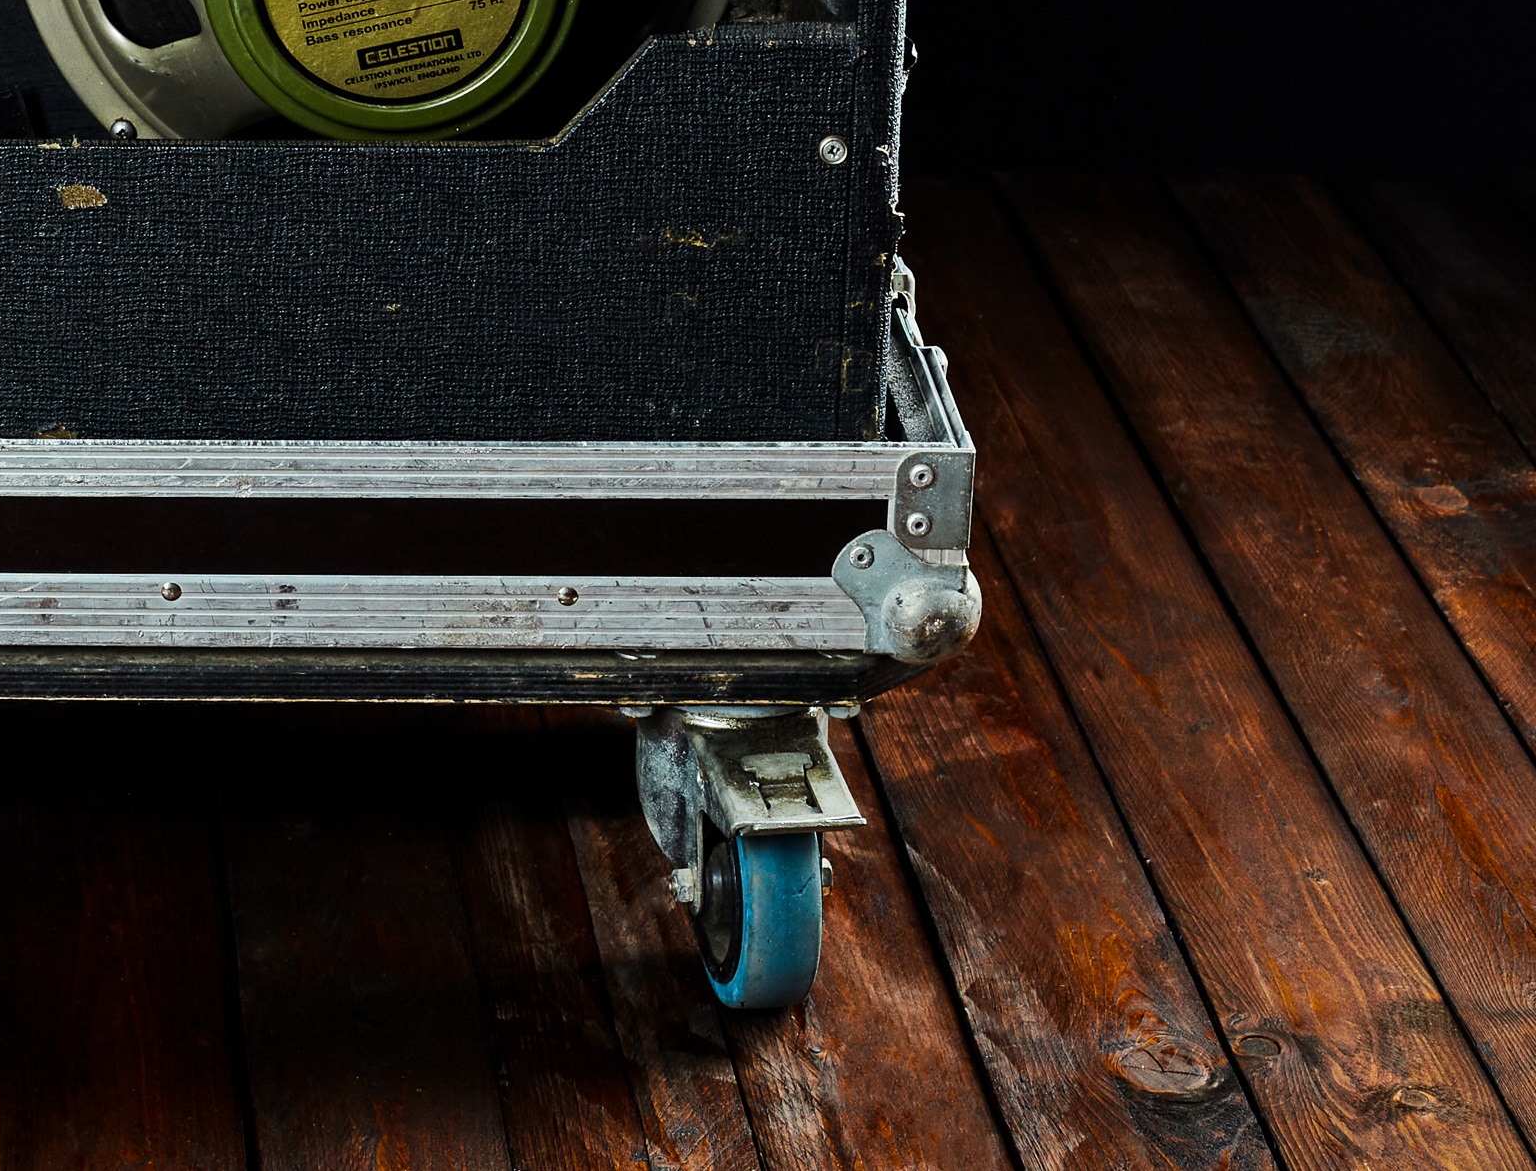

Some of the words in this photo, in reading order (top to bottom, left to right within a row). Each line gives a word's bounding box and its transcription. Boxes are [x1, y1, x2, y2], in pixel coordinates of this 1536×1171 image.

[301, 7, 376, 30] Impedance
[305, 32, 339, 47] Bass
[343, 16, 413, 38] resonance
[468, 0, 486, 11] 75
[365, 34, 457, 63] CELESTION
[344, 70, 392, 86] CELESTION
[394, 55, 465, 75] INTERNATIONAL
[467, 50, 485, 60] LTD.
[374, 76, 414, 90] IPSWICH,
[417, 67, 461, 80] ENGLAND
